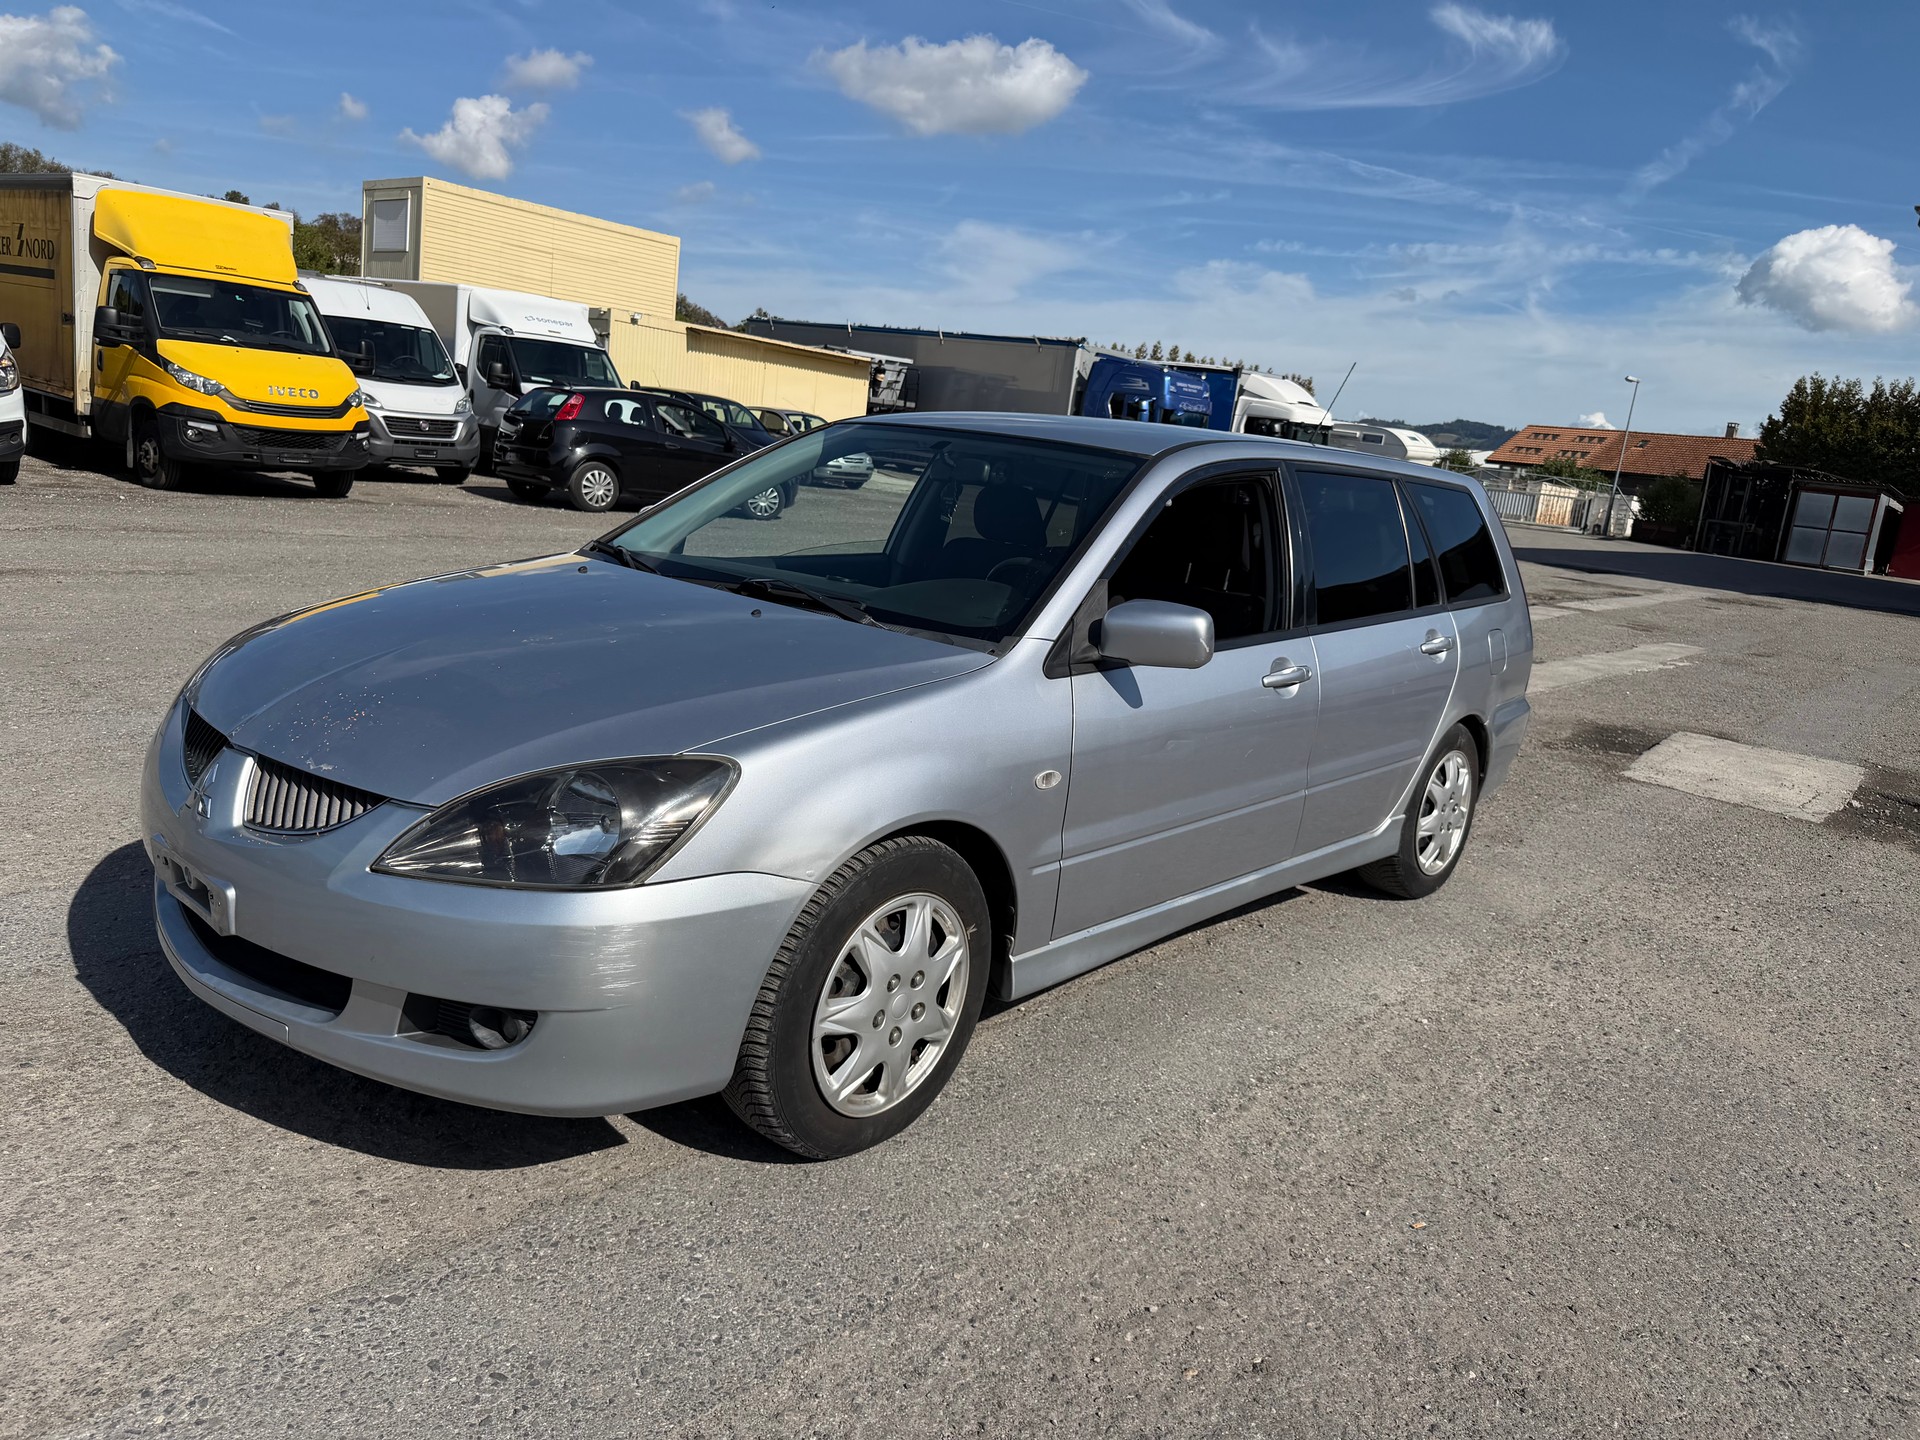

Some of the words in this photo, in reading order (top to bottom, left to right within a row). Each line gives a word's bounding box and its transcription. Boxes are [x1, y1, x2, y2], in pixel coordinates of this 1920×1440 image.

[0, 236, 12, 256] ER
[25, 238, 55, 260] NORD
[269, 385, 319, 399] IVECO
